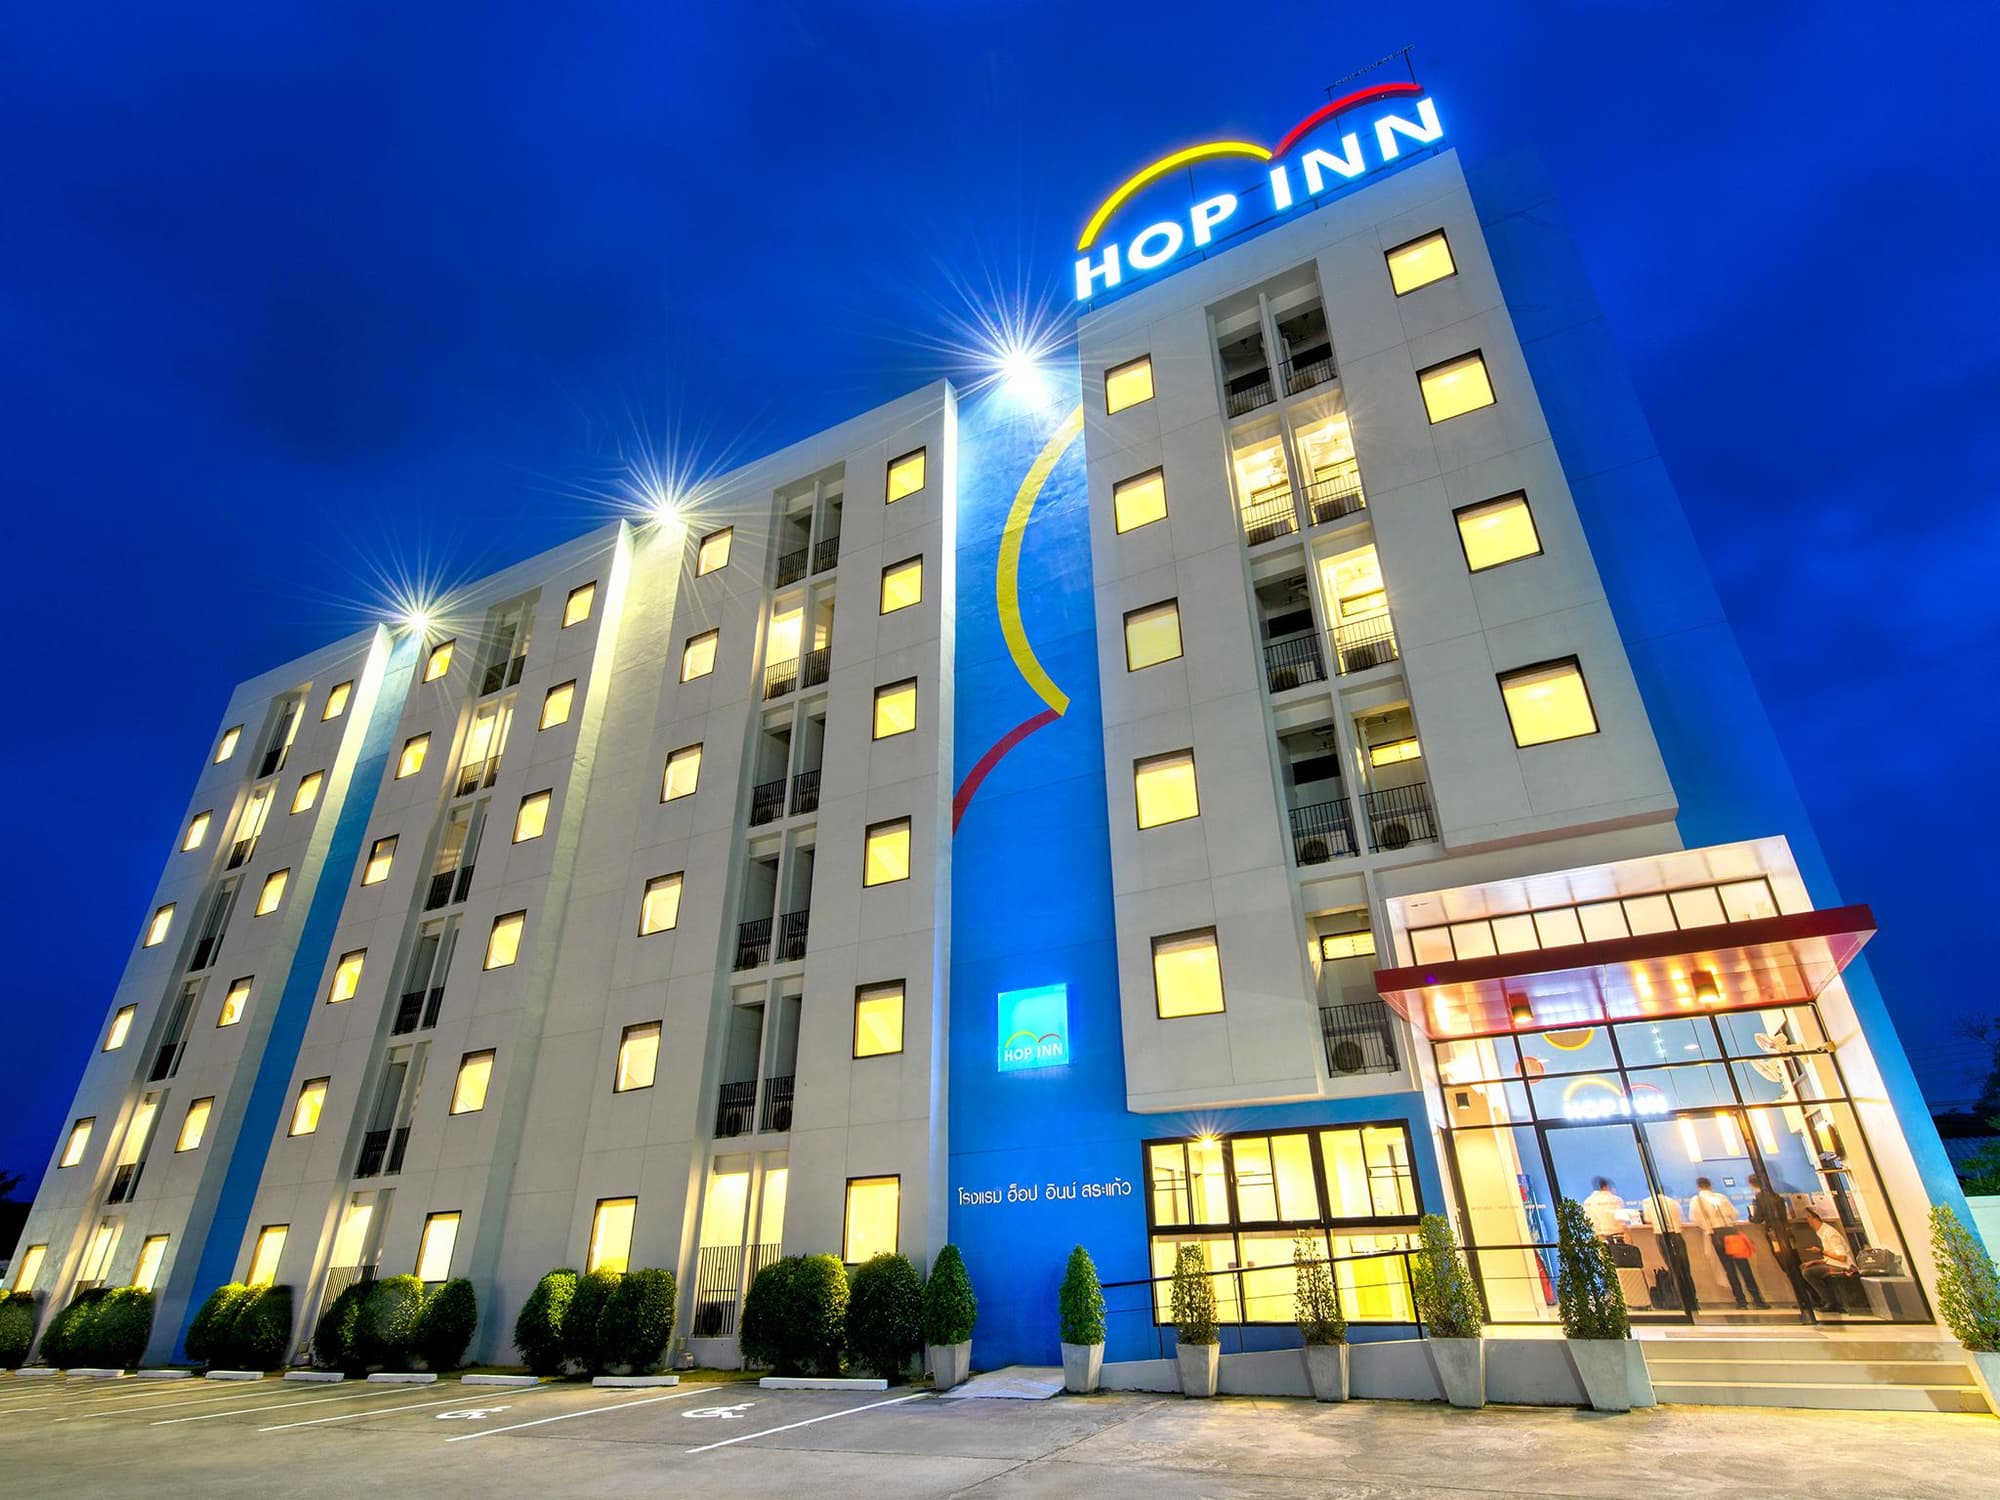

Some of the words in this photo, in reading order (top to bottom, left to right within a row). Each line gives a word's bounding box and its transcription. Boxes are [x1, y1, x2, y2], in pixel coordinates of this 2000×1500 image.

[1075, 193, 1238, 300] HOP
[1269, 96, 1444, 211] INN
[1004, 1047, 1032, 1062] HOP
[1037, 1042, 1063, 1057] INN
[958, 1187, 1002, 1205] โรงแรม
[1007, 1183, 1038, 1203] ฮ็อป
[1045, 1181, 1077, 1200] อินน์
[1081, 1177, 1132, 1198] สระแก้ว
